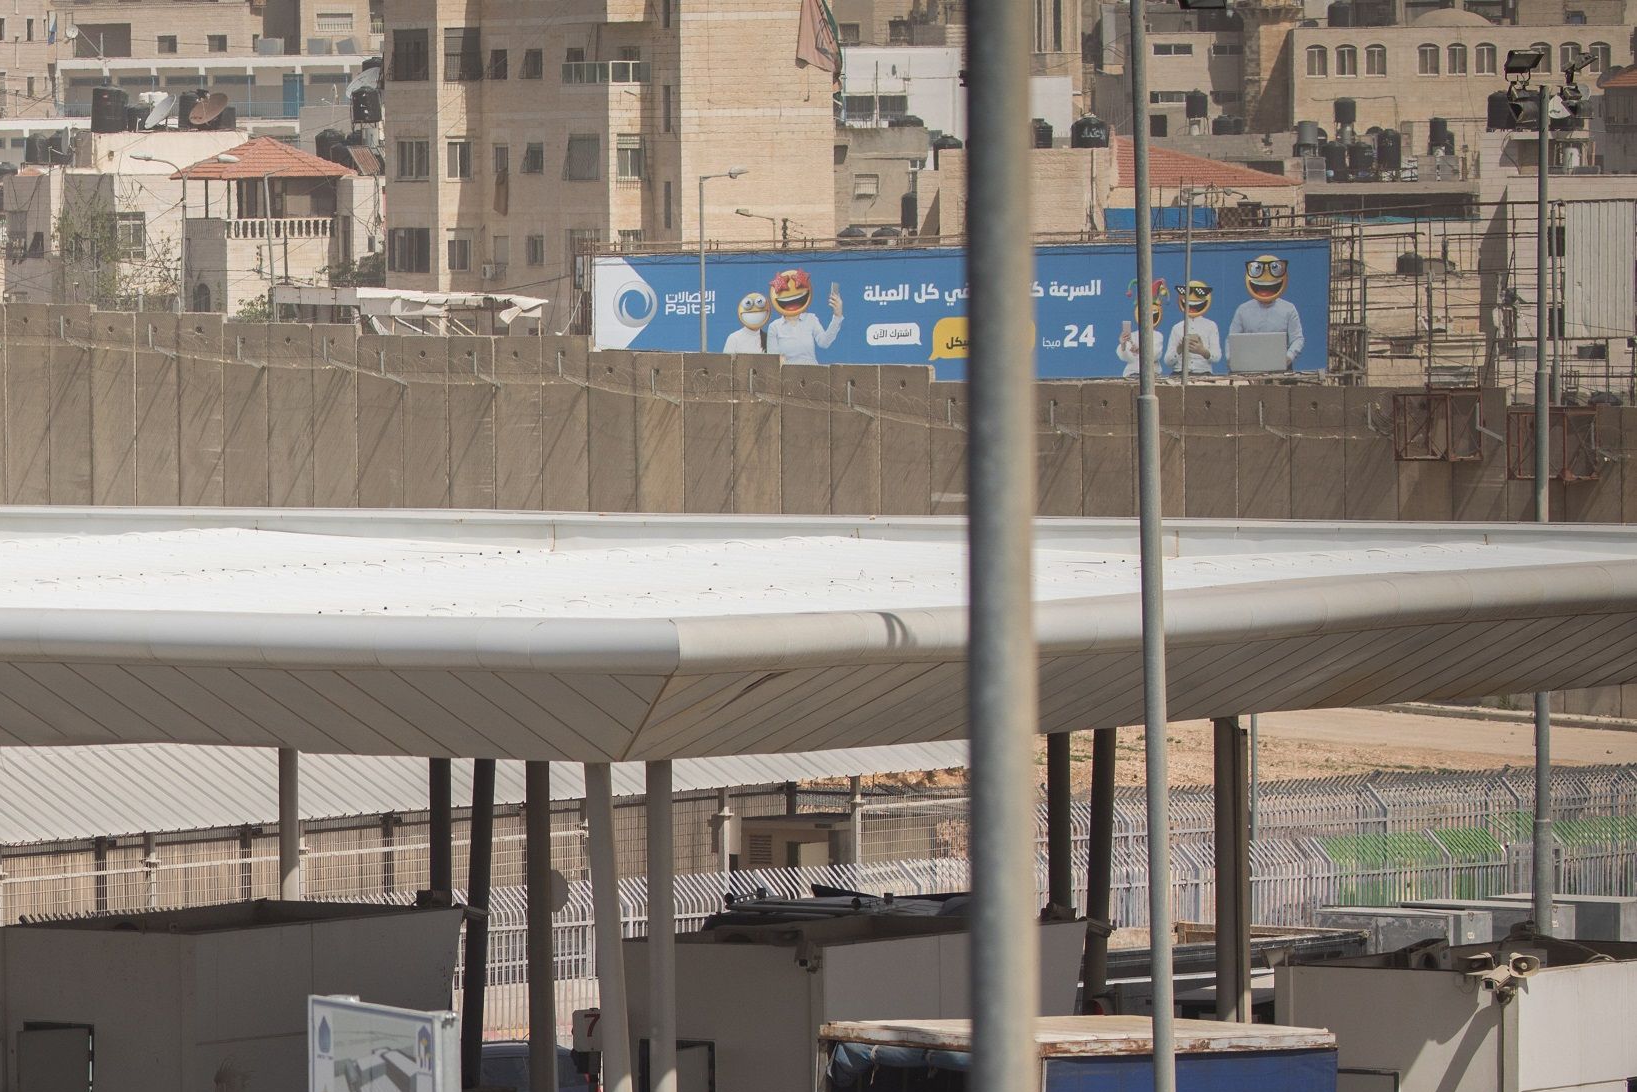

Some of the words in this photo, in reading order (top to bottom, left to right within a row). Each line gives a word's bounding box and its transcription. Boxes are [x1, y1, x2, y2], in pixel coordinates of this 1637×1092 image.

[665, 290, 715, 303] الاصالات
[863, 284, 910, 306] العيلة
[913, 282, 940, 304] كل
[1049, 279, 1102, 301] السرعة
[665, 303, 715, 316] Paltel
[873, 328, 888, 340] الآن
[889, 328, 912, 340] اشترك
[1063, 324, 1096, 348] 24
[583, 1013, 601, 1037] 7
